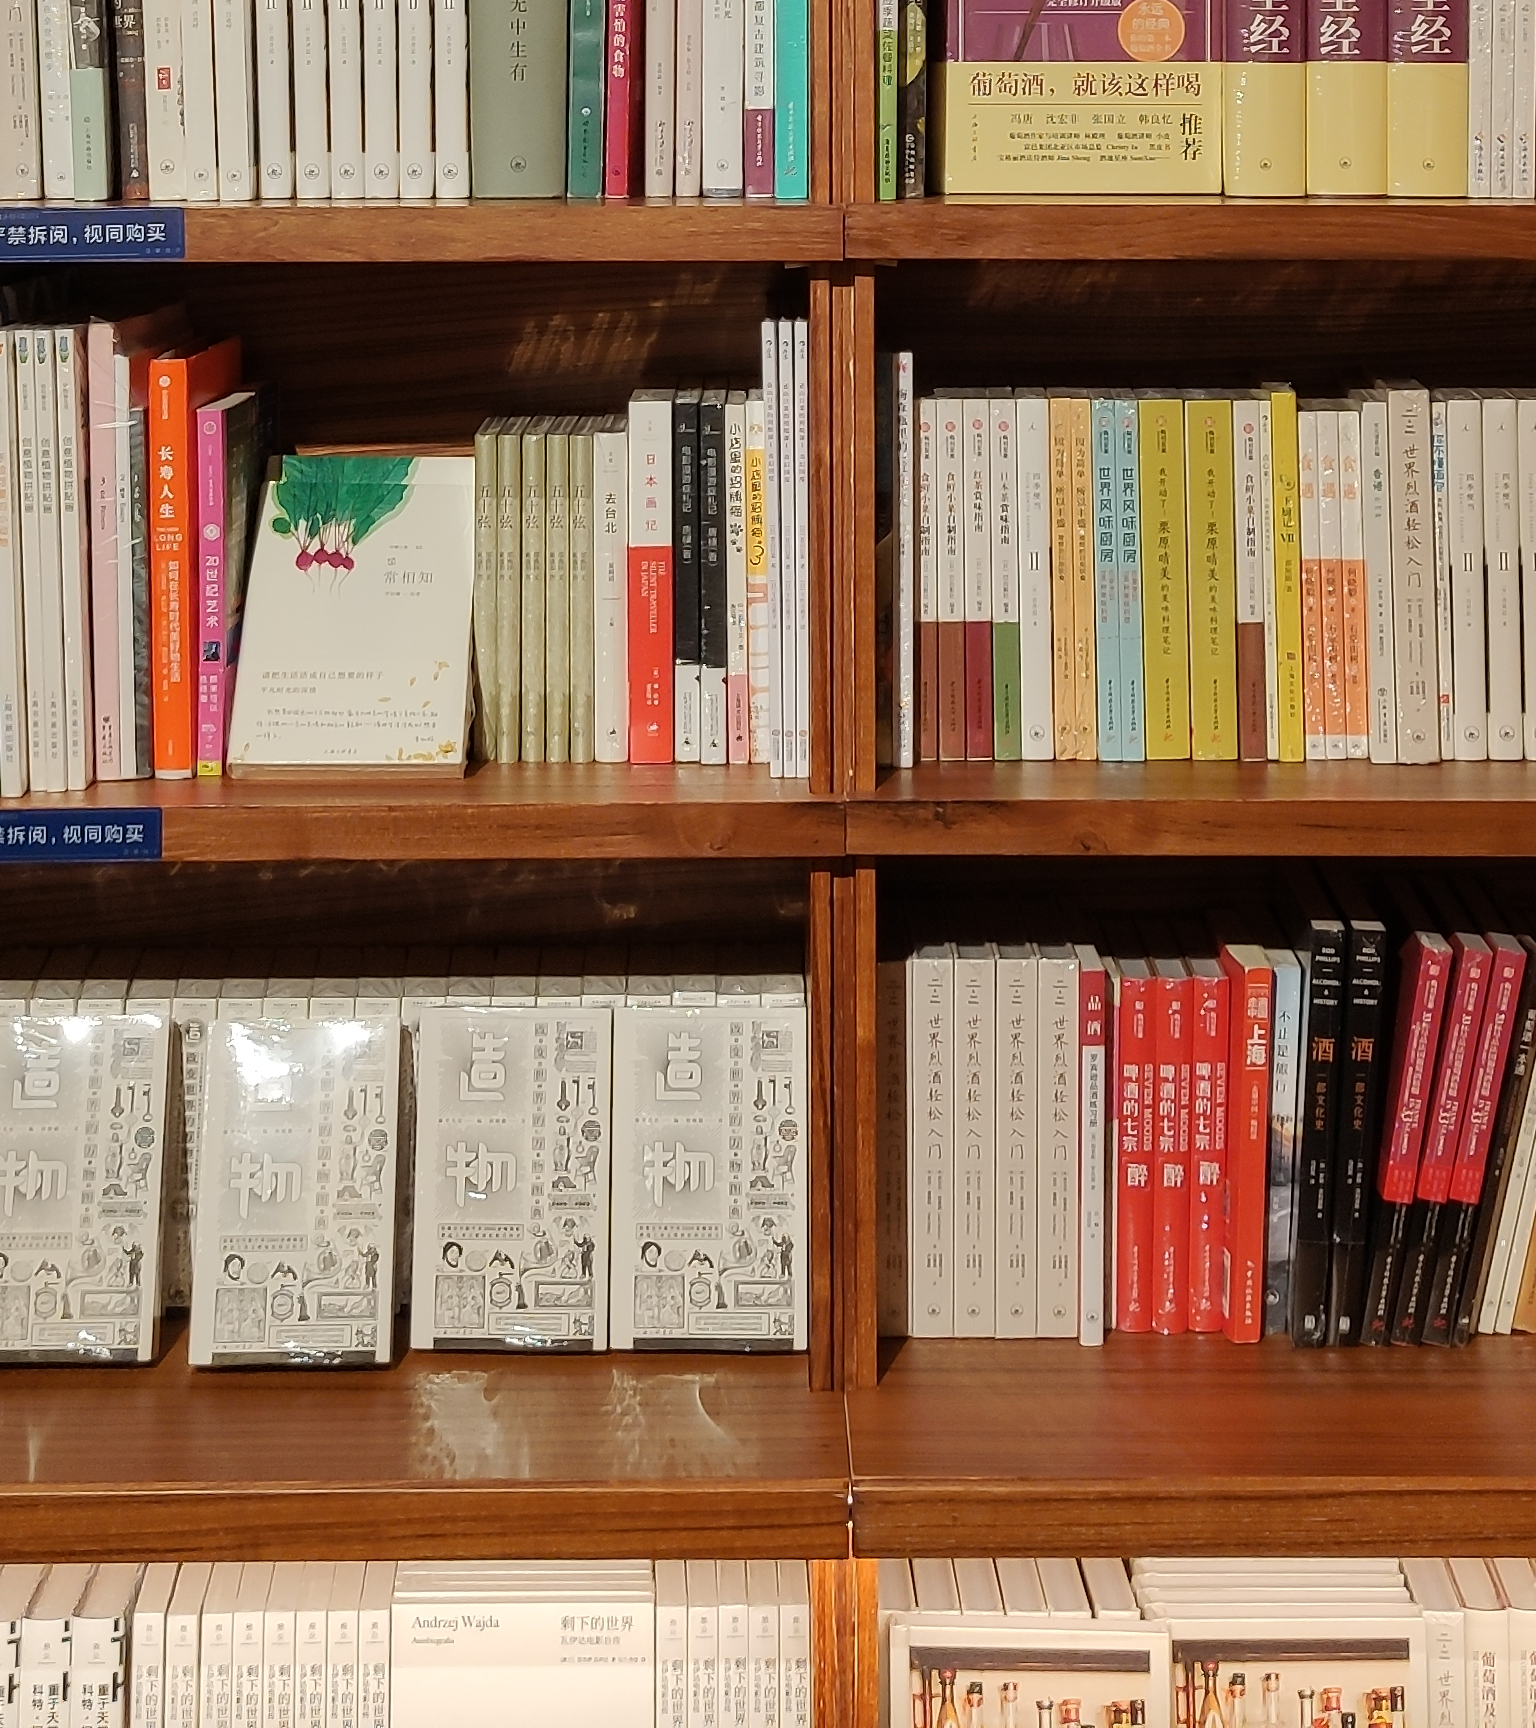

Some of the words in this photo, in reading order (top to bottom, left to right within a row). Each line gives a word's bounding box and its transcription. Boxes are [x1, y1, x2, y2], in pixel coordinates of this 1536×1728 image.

[969, 71, 1202, 99] 葡萄酒，就该这样喝
[1179, 112, 1204, 163] 推荐
[157, 444, 175, 520] 长寿人生
[729, 420, 743, 519] 小店里的招牌猫
[478, 485, 493, 530] 五十弦
[525, 485, 540, 530] 五十弦
[604, 492, 618, 534] 去台北
[644, 453, 658, 532] 日本画记
[1098, 467, 1114, 564] 世界风味厨房
[1121, 467, 1137, 564] 世界风味厨房
[1402, 444, 1423, 588] 世界烈酒轻松入门
[383, 569, 434, 585] 常相知
[1245, 1023, 1268, 1065] 上海
[1311, 1036, 1336, 1063] 酒
[1351, 1036, 1375, 1063] 酒
[926, 1013, 944, 1162] 世界烈酒轻松入门
[411, 1615, 458, 1632] Andrzej
[461, 1615, 500, 1630] Wajda
[560, 1615, 635, 1632] 剩下的世界
